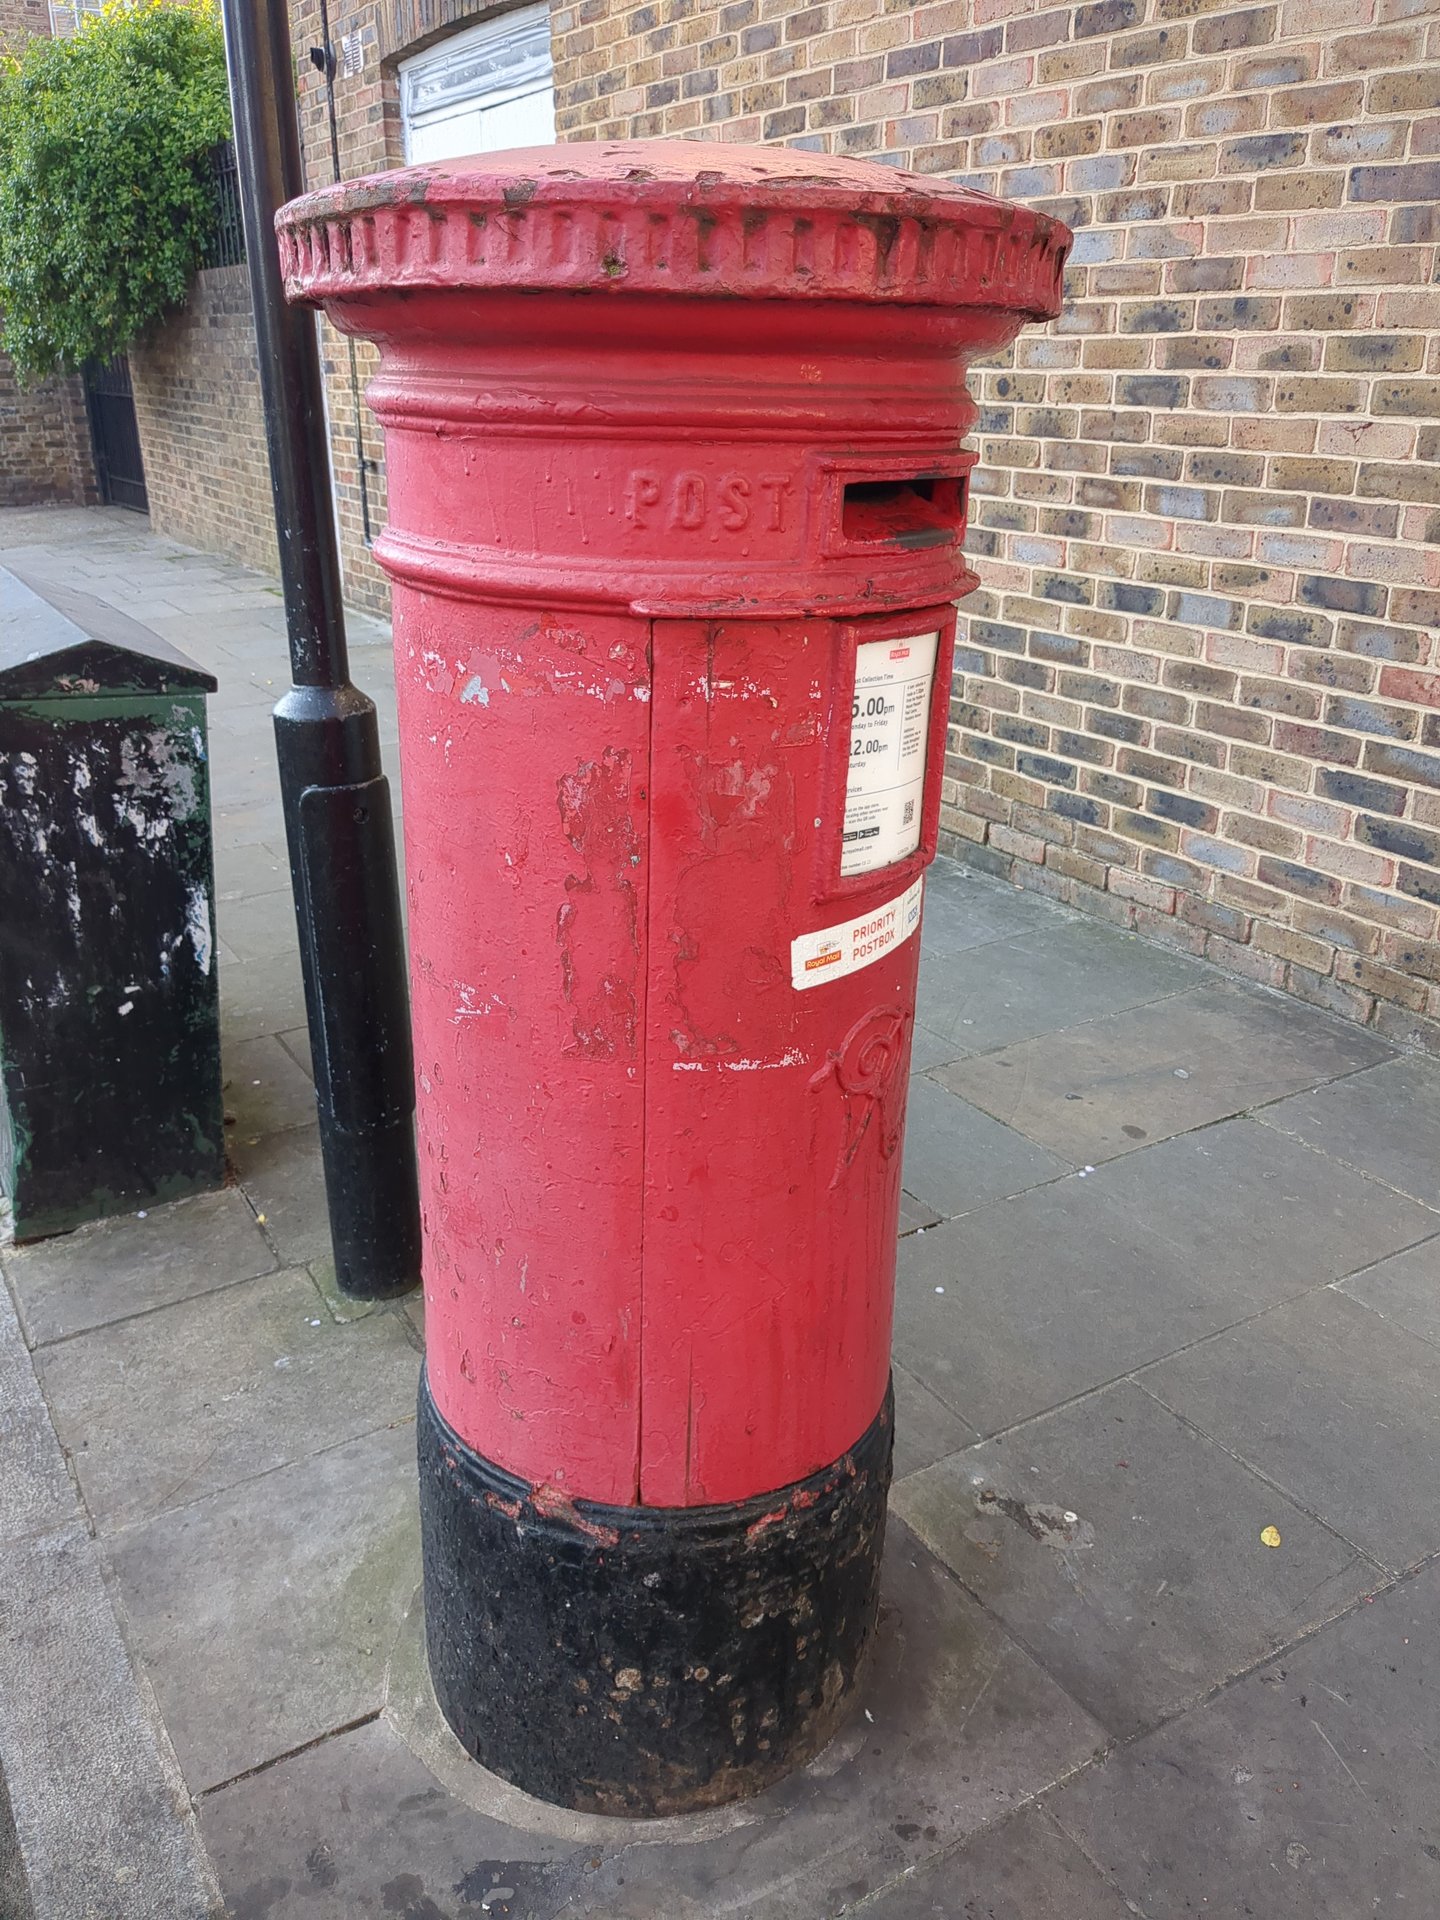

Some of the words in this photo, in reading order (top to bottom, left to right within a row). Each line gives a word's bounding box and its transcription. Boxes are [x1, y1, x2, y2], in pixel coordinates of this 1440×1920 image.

[625, 469, 793, 532] POST
[862, 675, 883, 683] Collection
[853, 910, 896, 942] PRIORITY
[806, 957, 826, 969] Royal
[826, 951, 840, 962] Mail
[853, 929, 895, 961] POSTBOX
